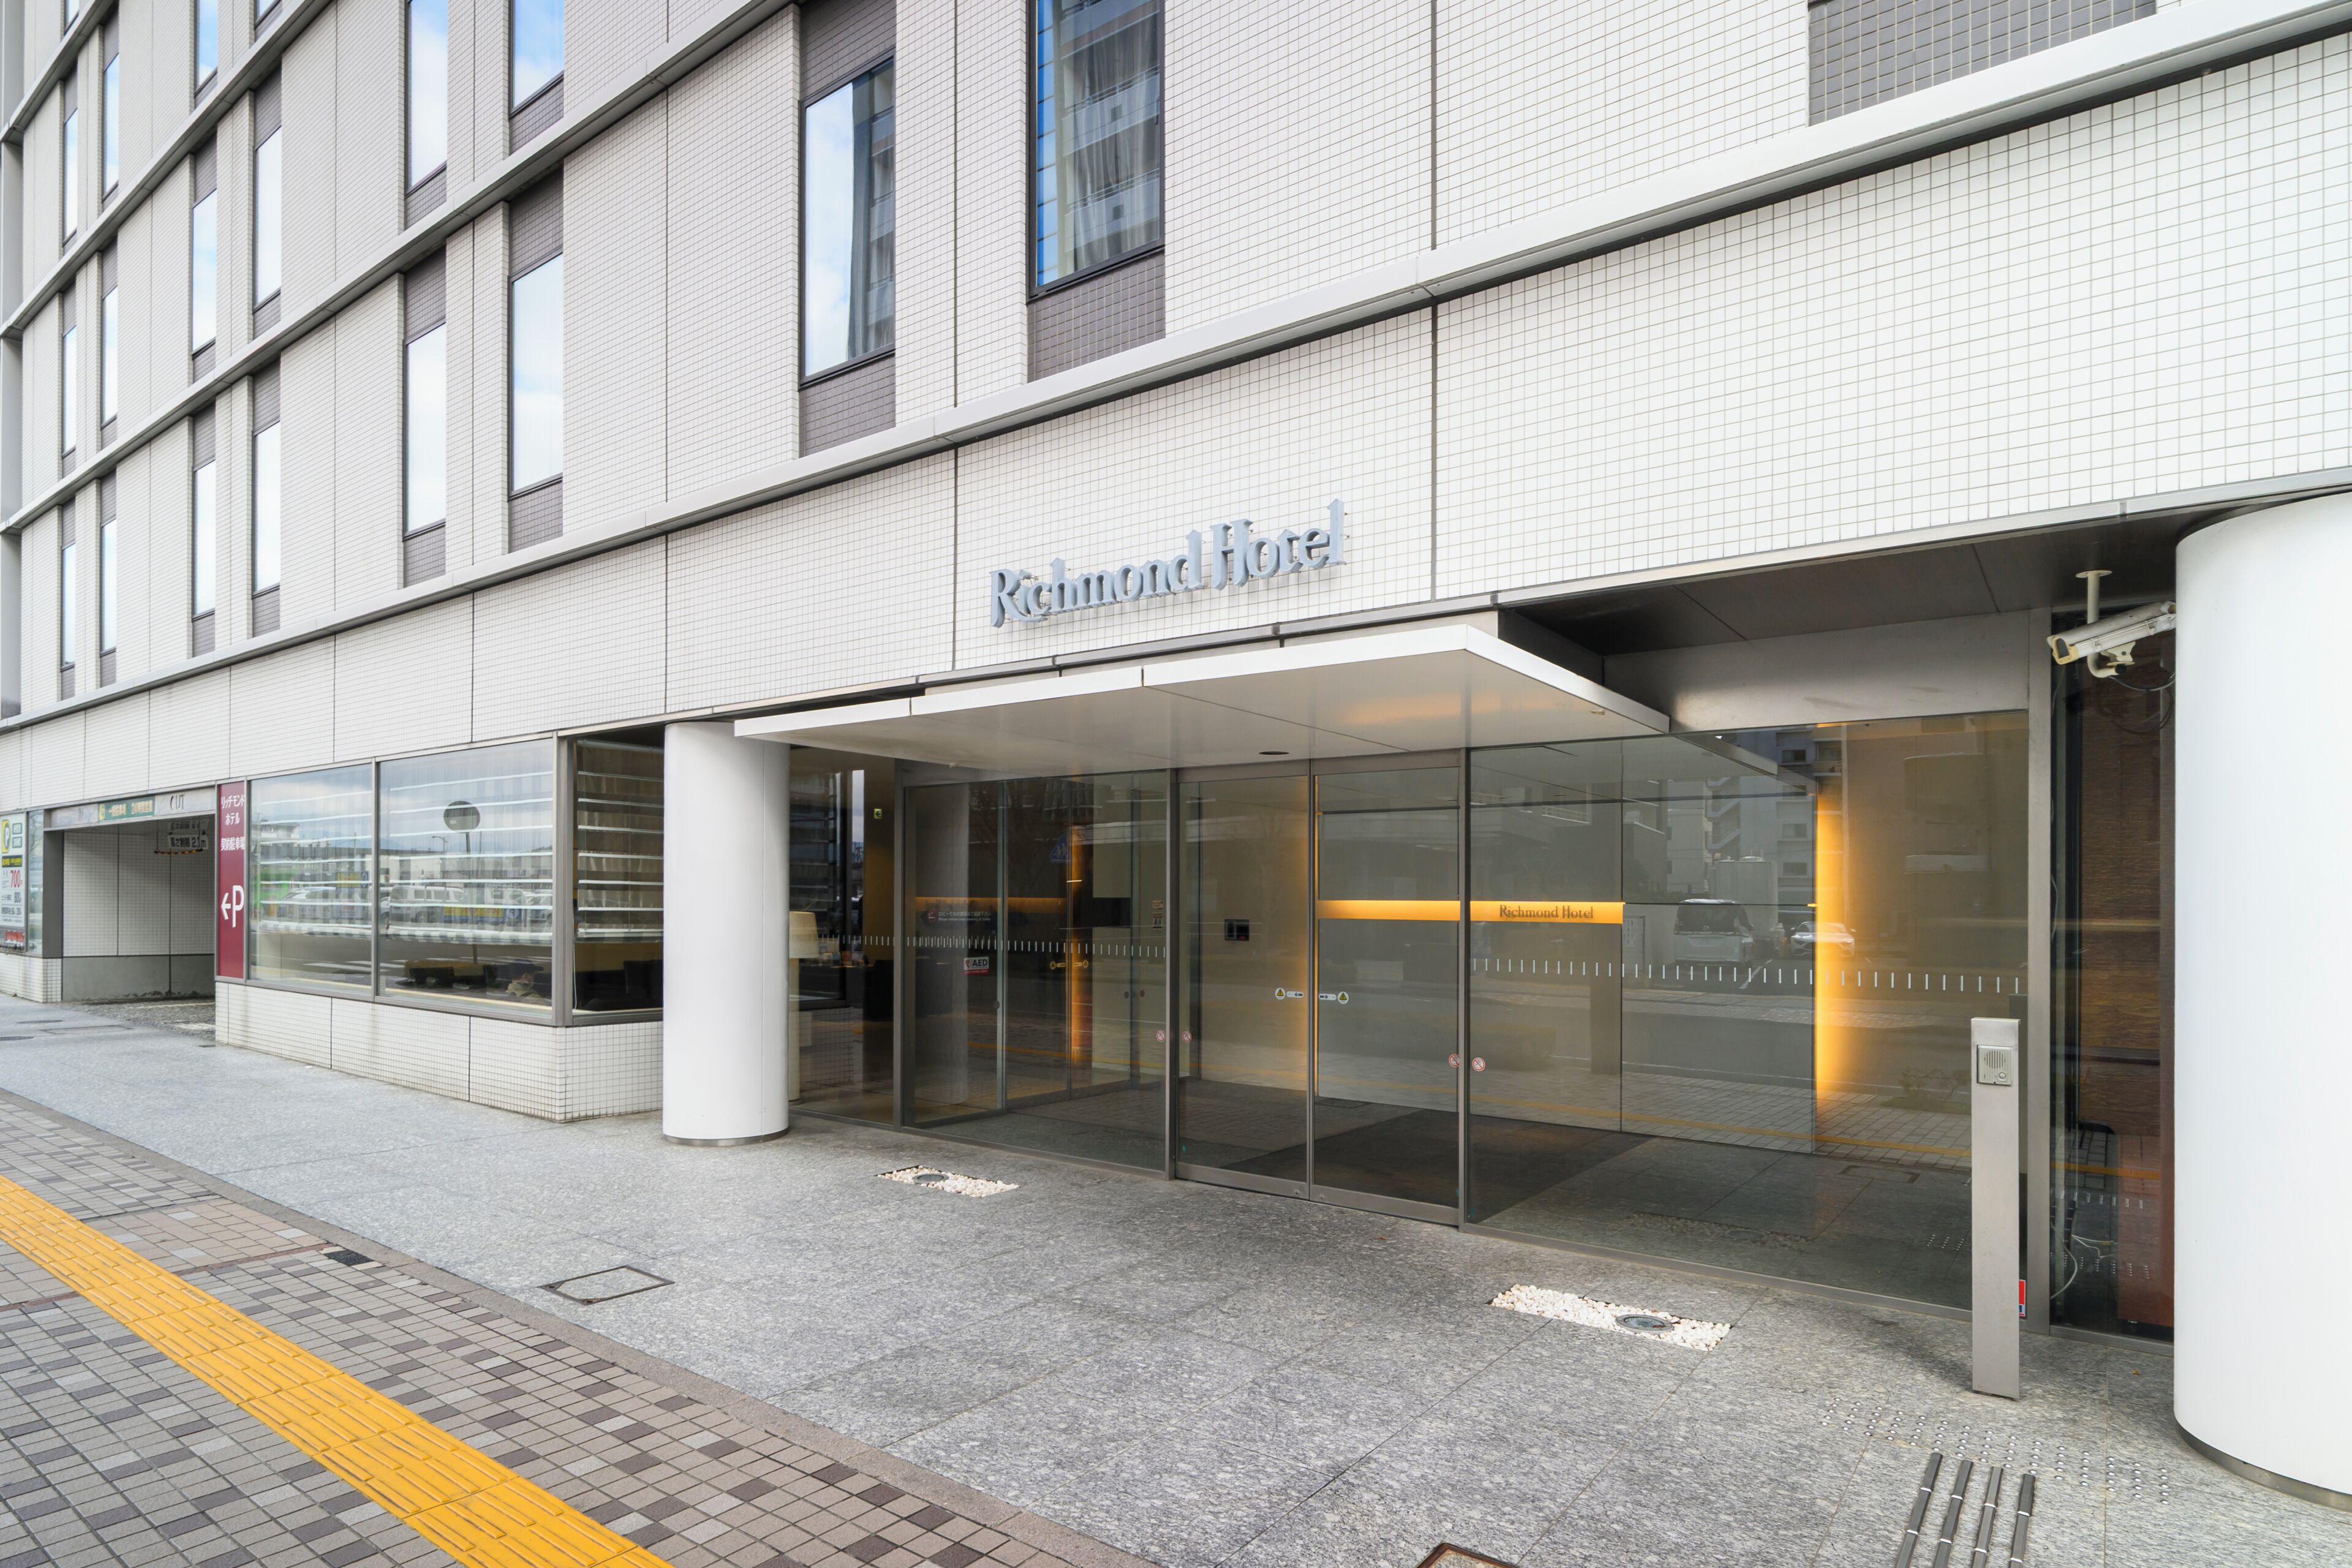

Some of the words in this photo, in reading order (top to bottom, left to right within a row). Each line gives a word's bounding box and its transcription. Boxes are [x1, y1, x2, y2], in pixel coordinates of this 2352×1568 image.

[989, 529, 1204, 628] Richmond
[1210, 498, 1347, 592] Hotel
[221, 794, 245, 809] リッチモンド
[225, 812, 241, 825] ホテル
[232, 885, 244, 928] P
[1499, 905, 1559, 918] Richmond
[1562, 905, 1594, 919] Hotel
